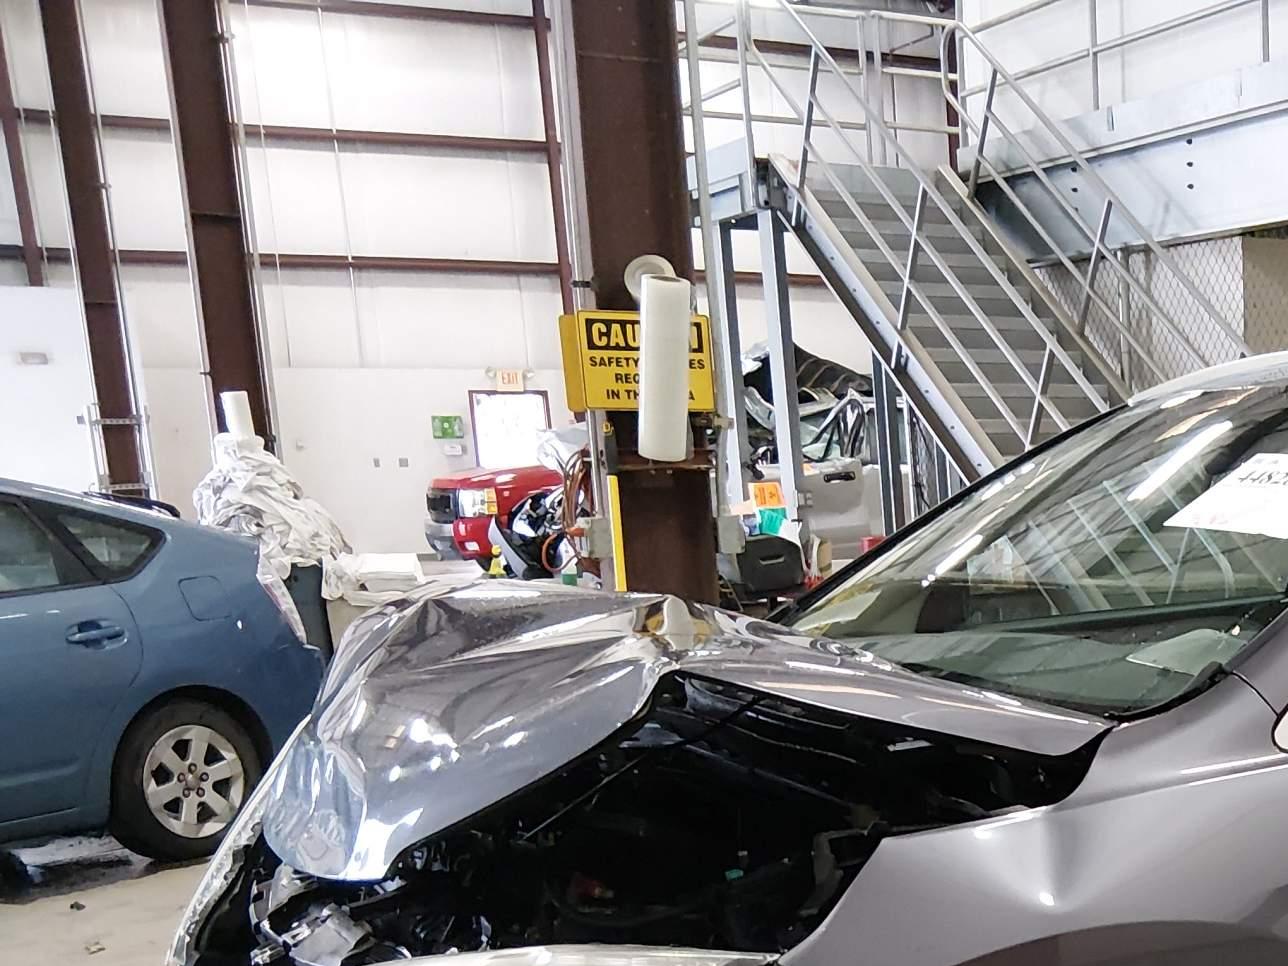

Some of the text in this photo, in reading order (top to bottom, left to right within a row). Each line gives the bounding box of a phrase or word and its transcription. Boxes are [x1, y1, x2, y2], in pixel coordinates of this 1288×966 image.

[589, 356, 640, 368] SAFETY
[501, 372, 519, 385] EXIT
[606, 388, 621, 400] IN
